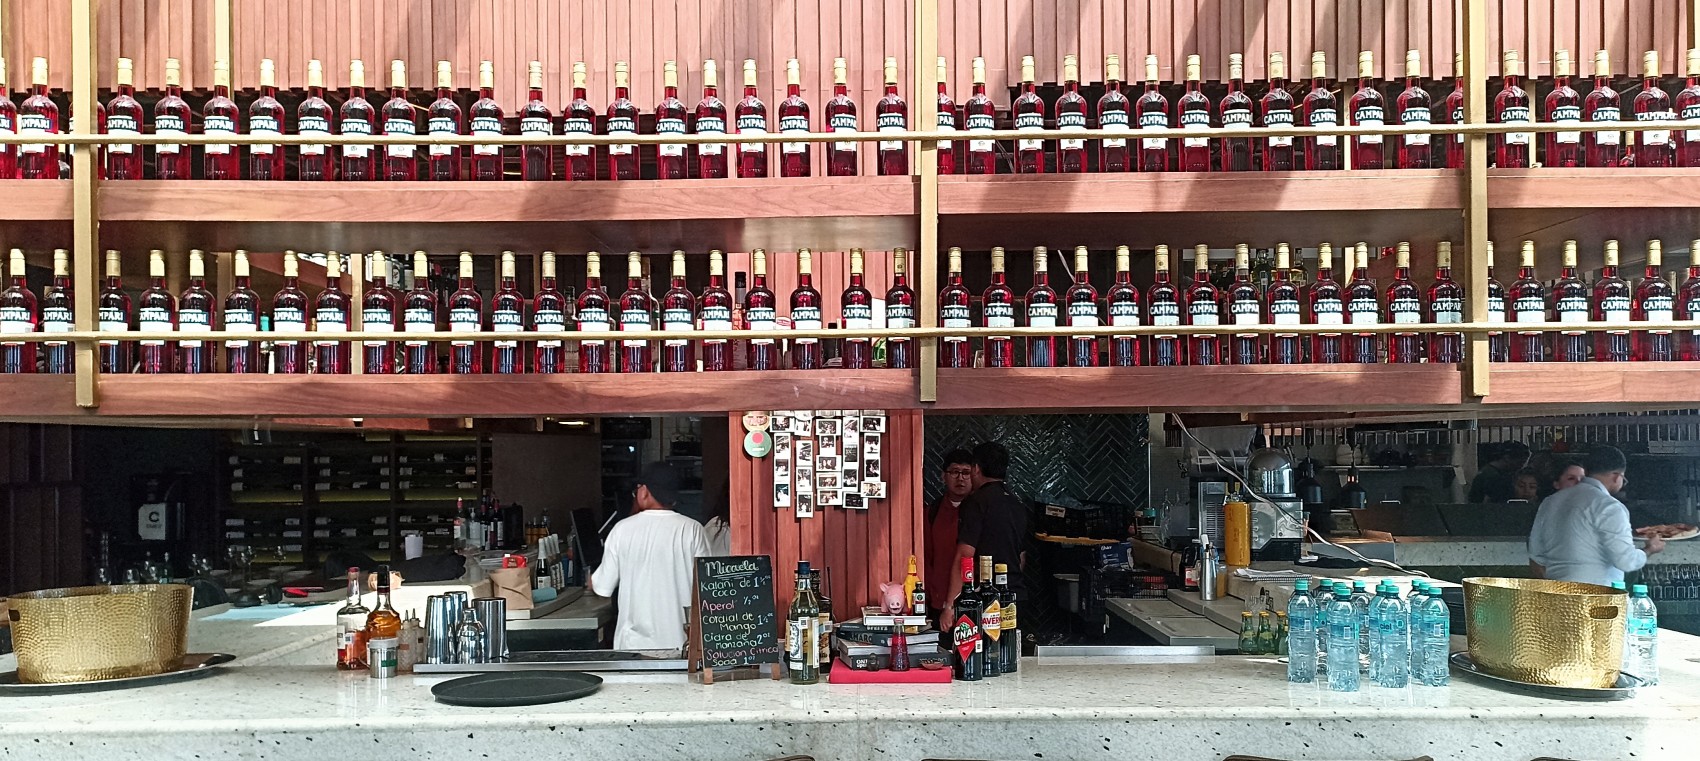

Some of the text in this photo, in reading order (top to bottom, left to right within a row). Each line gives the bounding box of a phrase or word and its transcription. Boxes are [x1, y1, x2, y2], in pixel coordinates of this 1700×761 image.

[22, 118, 50, 129] AMPARI
[1139, 114, 1168, 126] CAMPAR
[1263, 112, 1293, 124] CAMPAR
[108, 118, 136, 130] AMPARI
[155, 119, 183, 130] AMPARI
[204, 119, 232, 131] AMPARI
[250, 119, 277, 131] AMPARI
[385, 121, 415, 134] CAMPAR
[429, 121, 455, 132] AMPARI
[1432, 301, 1461, 311] CAMPAR
[0, 310, 30, 321] AMPARI
[44, 310, 72, 321] AMPARI
[99, 310, 124, 321] MPARI
[179, 312, 206, 323] AMPARI
[225, 312, 252, 323] AMPARI
[274, 311, 302, 322] AMPARI
[317, 311, 343, 322] AMPARI
[363, 312, 390, 323] AMPARI
[706, 560, 760, 576] Micaela
[700, 580, 734, 591] Kalani
[739, 577, 751, 588] de
[702, 600, 735, 615] Aperol
[702, 613, 738, 625] Cordial
[742, 612, 754, 621] de
[982, 617, 1000, 625] AVER
[720, 623, 757, 636] Mango
[703, 633, 732, 642] Cidra
[954, 626, 978, 645] CYNAR
[712, 658, 738, 667] Soda
